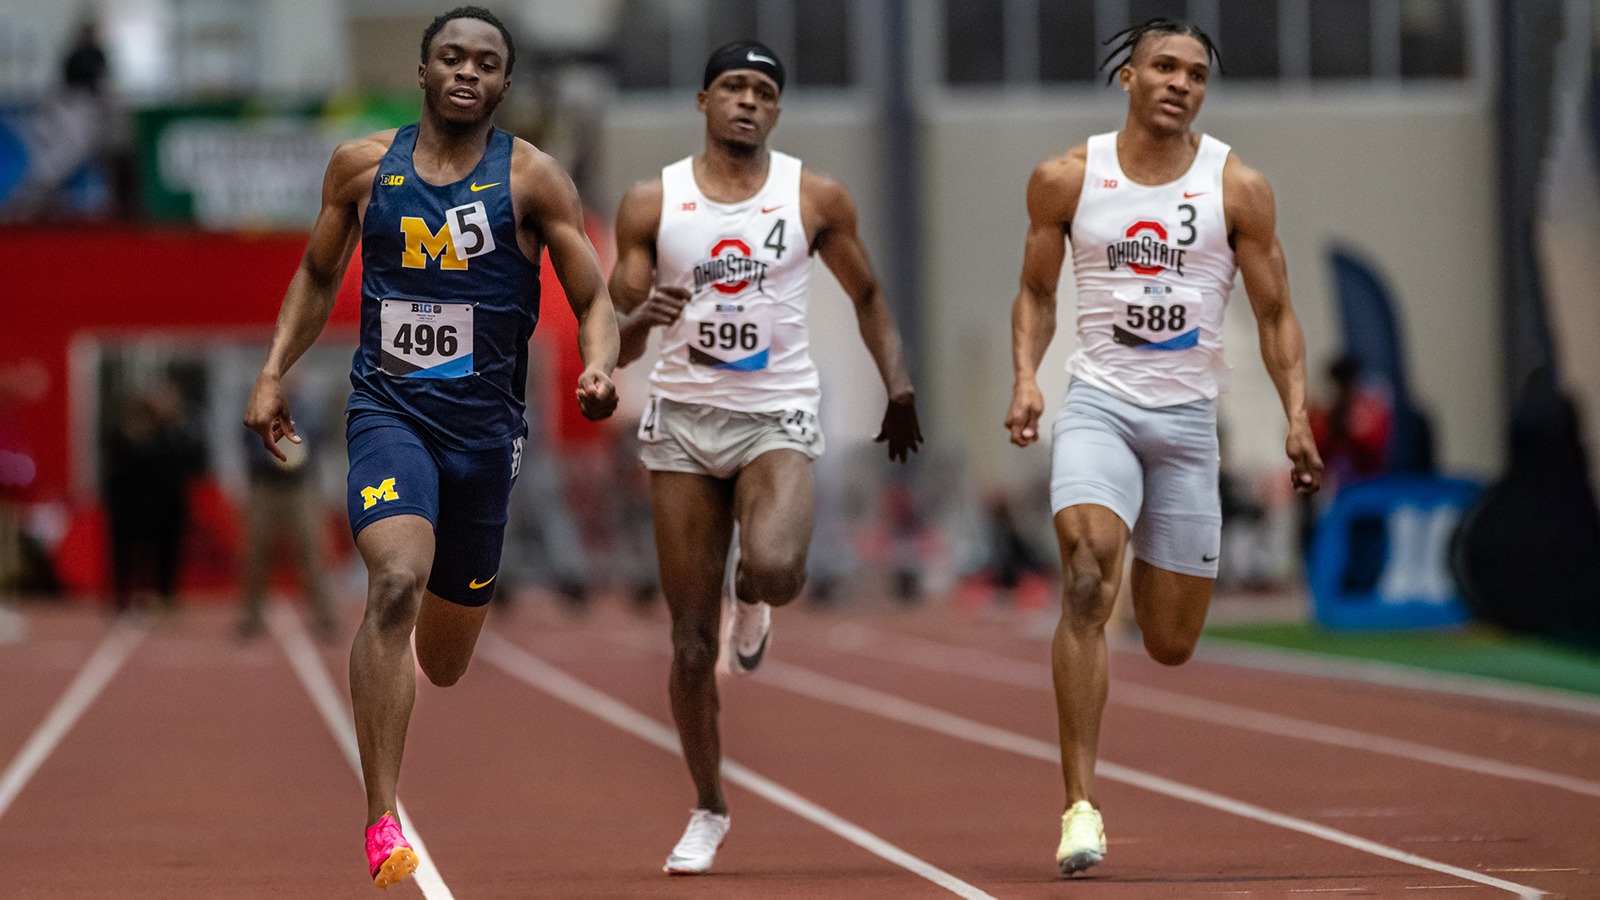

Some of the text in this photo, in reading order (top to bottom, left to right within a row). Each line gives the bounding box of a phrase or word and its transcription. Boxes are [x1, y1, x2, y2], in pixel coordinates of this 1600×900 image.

[400, 216, 468, 270] M
[455, 206, 485, 255] 5
[763, 218, 786, 260] 4
[1177, 204, 1197, 247] 3
[698, 321, 759, 351] 596
[1126, 304, 1186, 333] 588
[393, 323, 458, 357] 496
[361, 477, 399, 511] M
